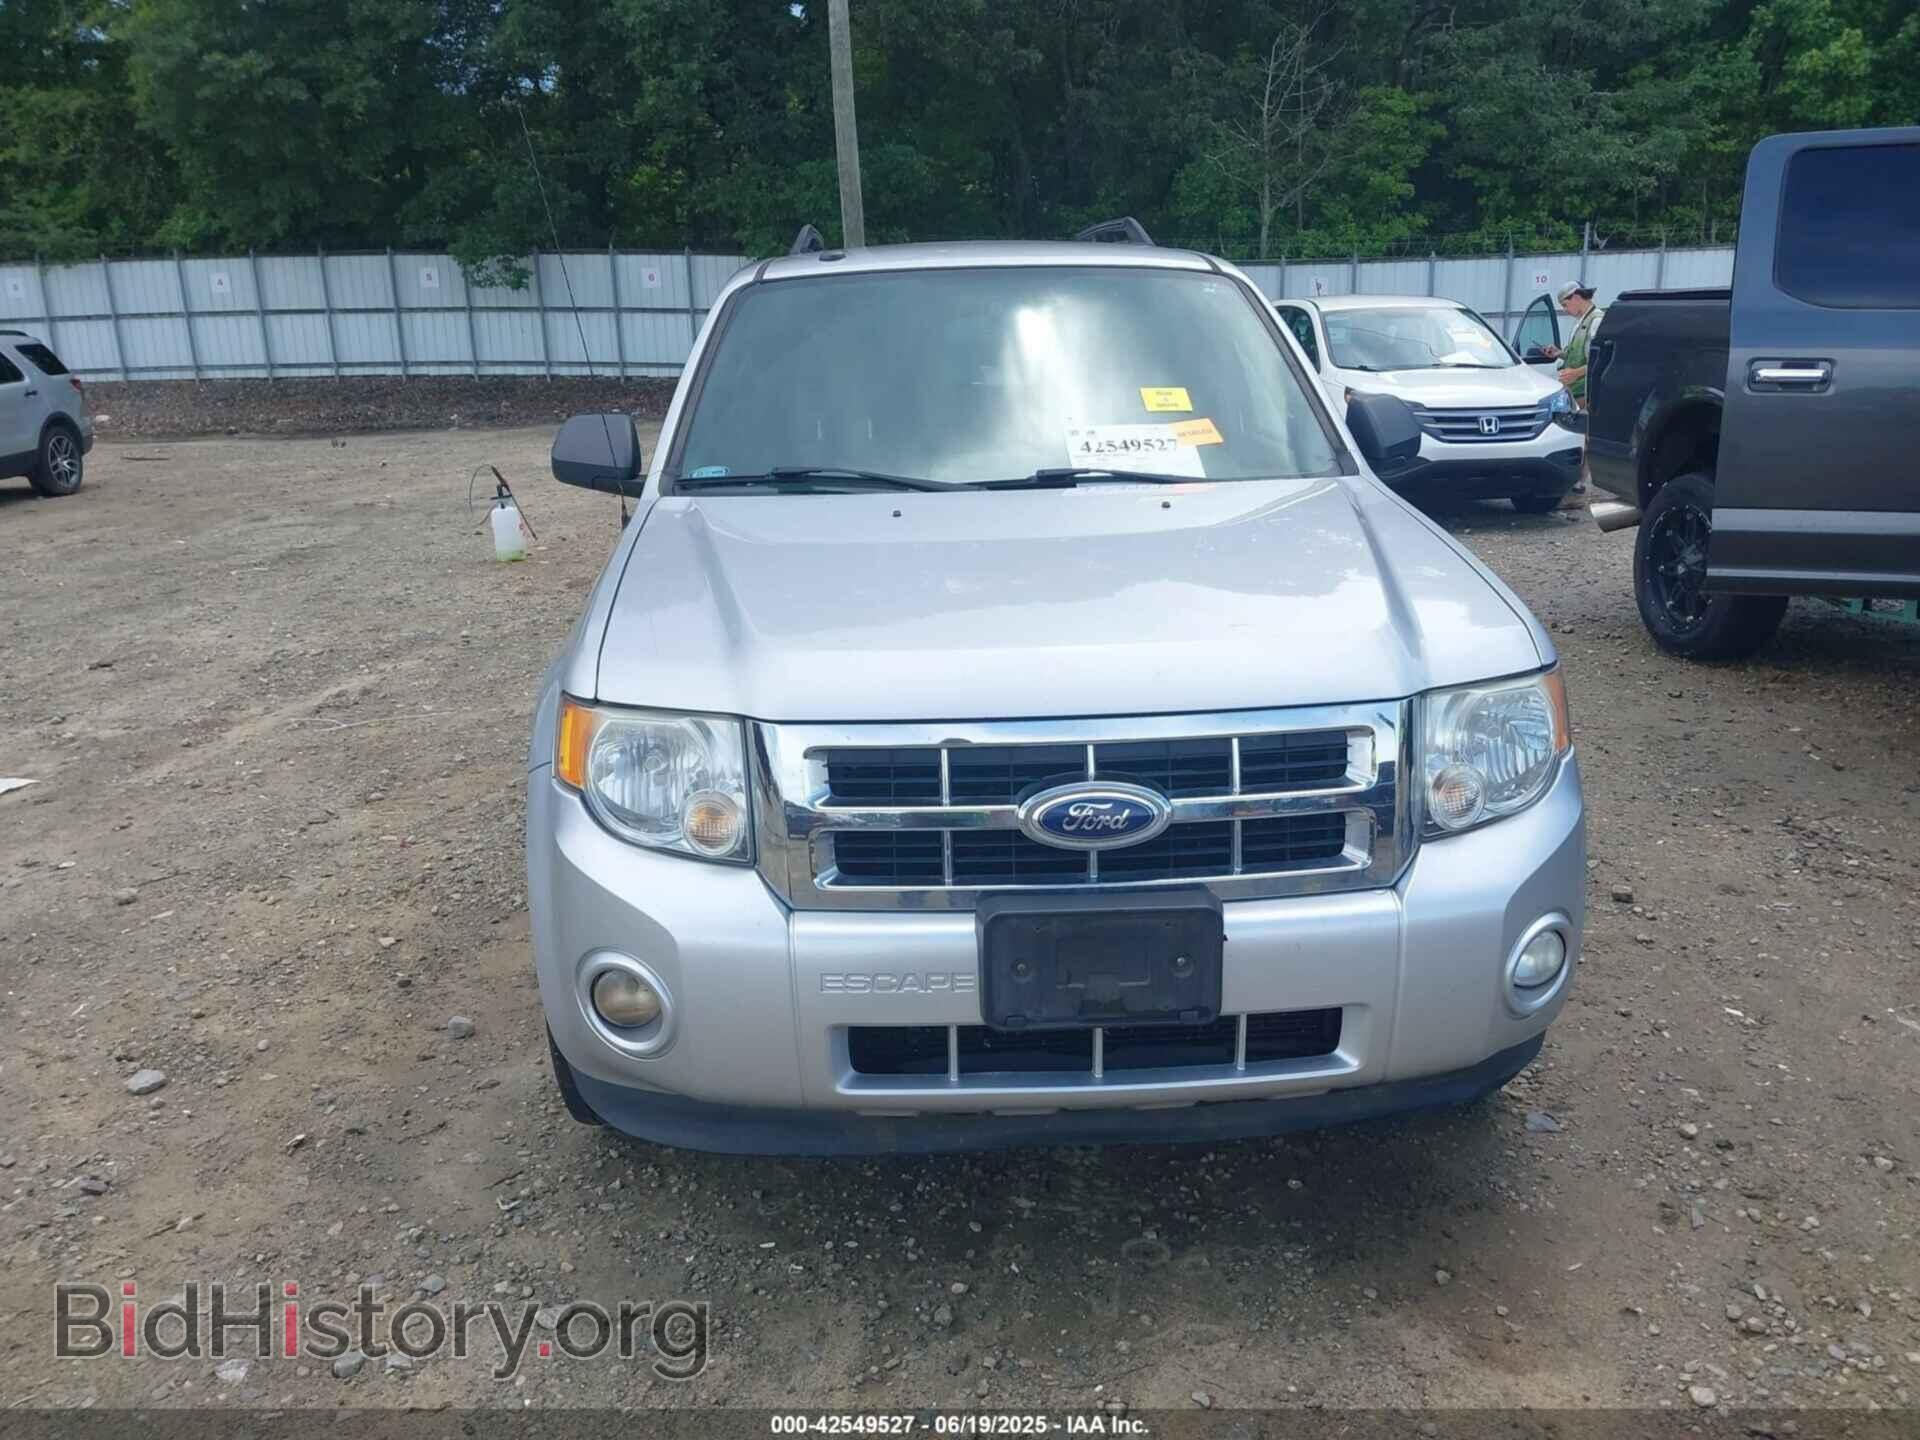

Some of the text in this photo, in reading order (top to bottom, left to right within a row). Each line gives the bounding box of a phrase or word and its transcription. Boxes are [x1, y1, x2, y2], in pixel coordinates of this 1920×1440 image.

[1535, 275, 1548, 284] 10
[1079, 438, 1176, 453] 42549527
[1062, 802, 1131, 831] Ford
[819, 972, 975, 994] ESCAPE
